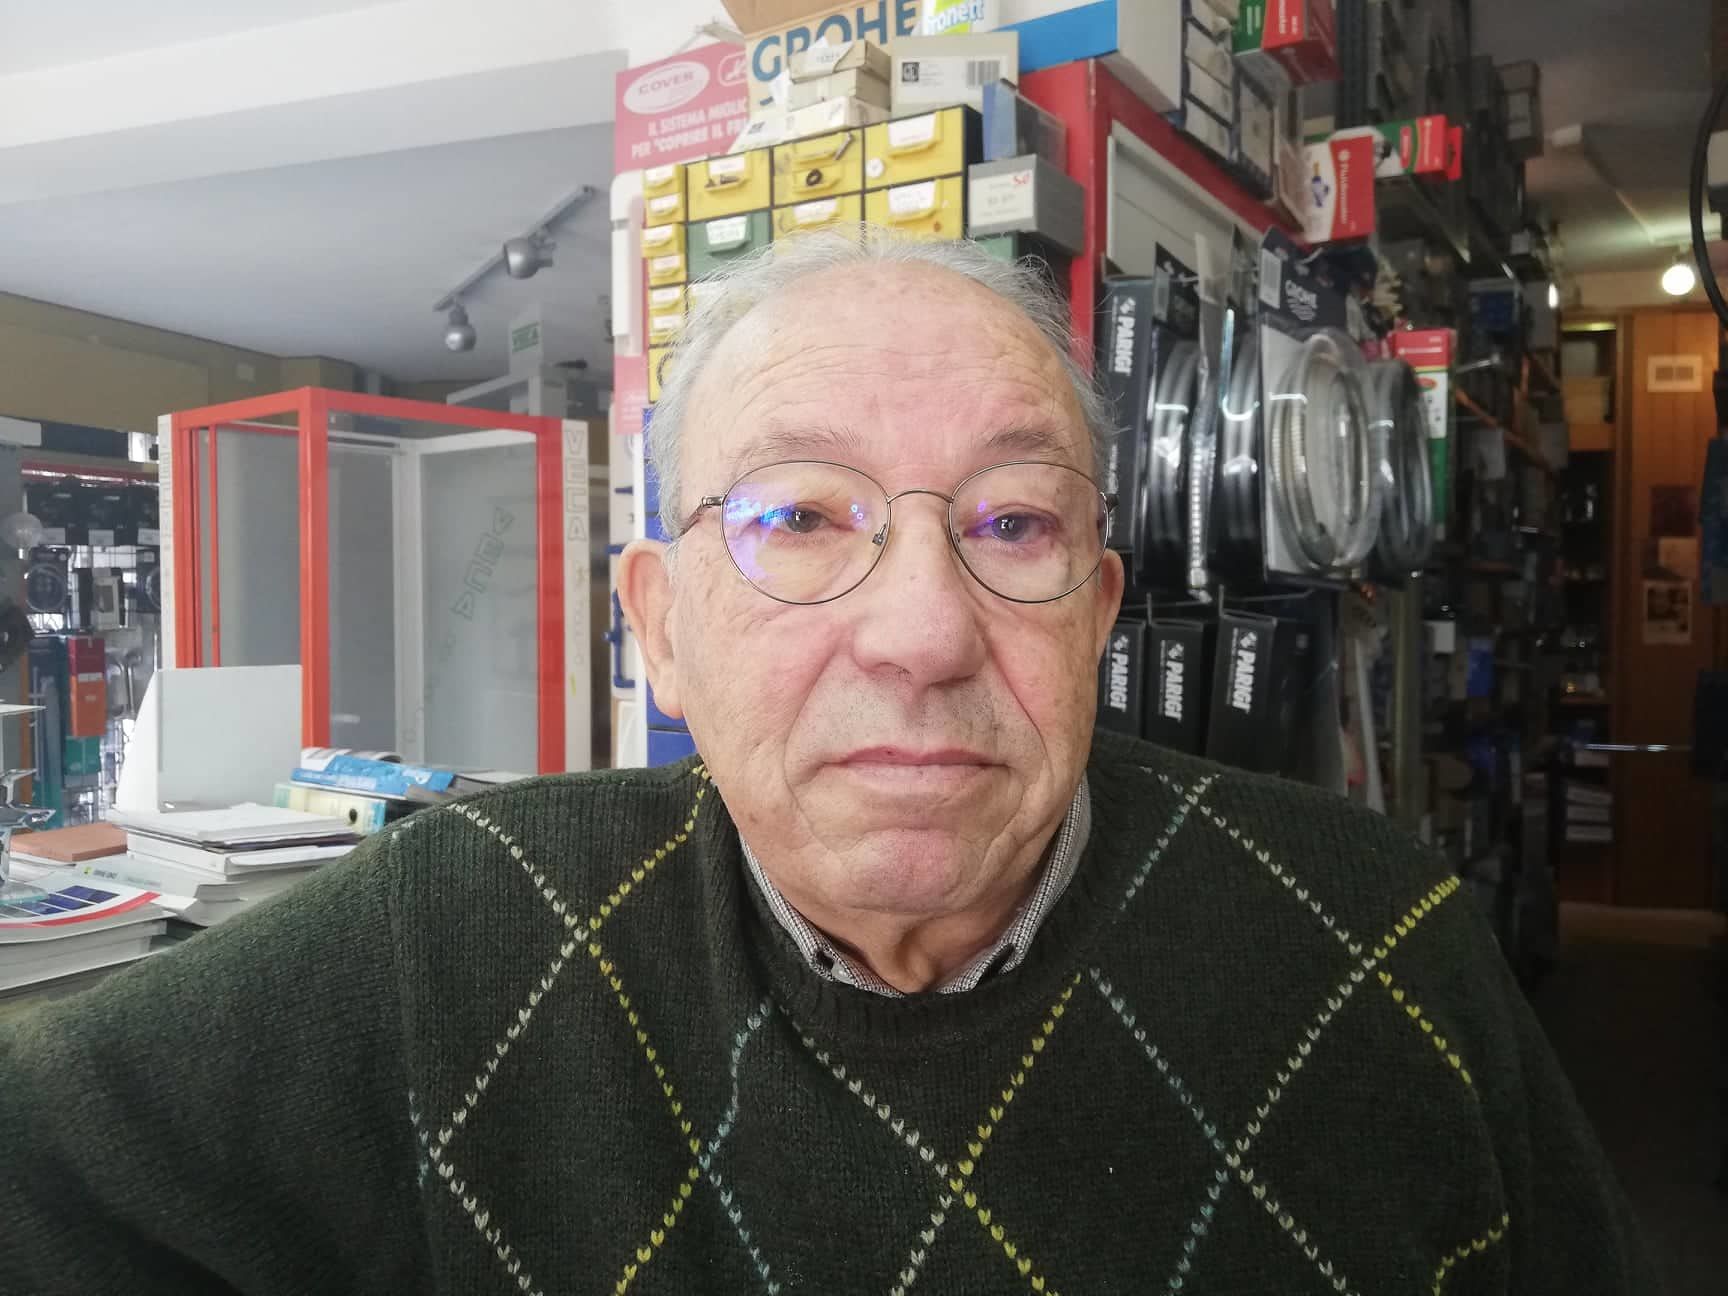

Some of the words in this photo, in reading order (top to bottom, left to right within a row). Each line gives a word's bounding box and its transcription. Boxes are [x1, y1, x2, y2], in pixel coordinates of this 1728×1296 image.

[752, 0, 917, 82] GROHE
[639, 71, 694, 95] COVER
[631, 140, 651, 158] PER
[660, 109, 706, 133] SISTEMA
[1114, 315, 1136, 377] PARIGI
[1110, 651, 1129, 713] PARIGI
[1165, 660, 1184, 723] PARIGI
[1232, 650, 1256, 714] PARIGI
